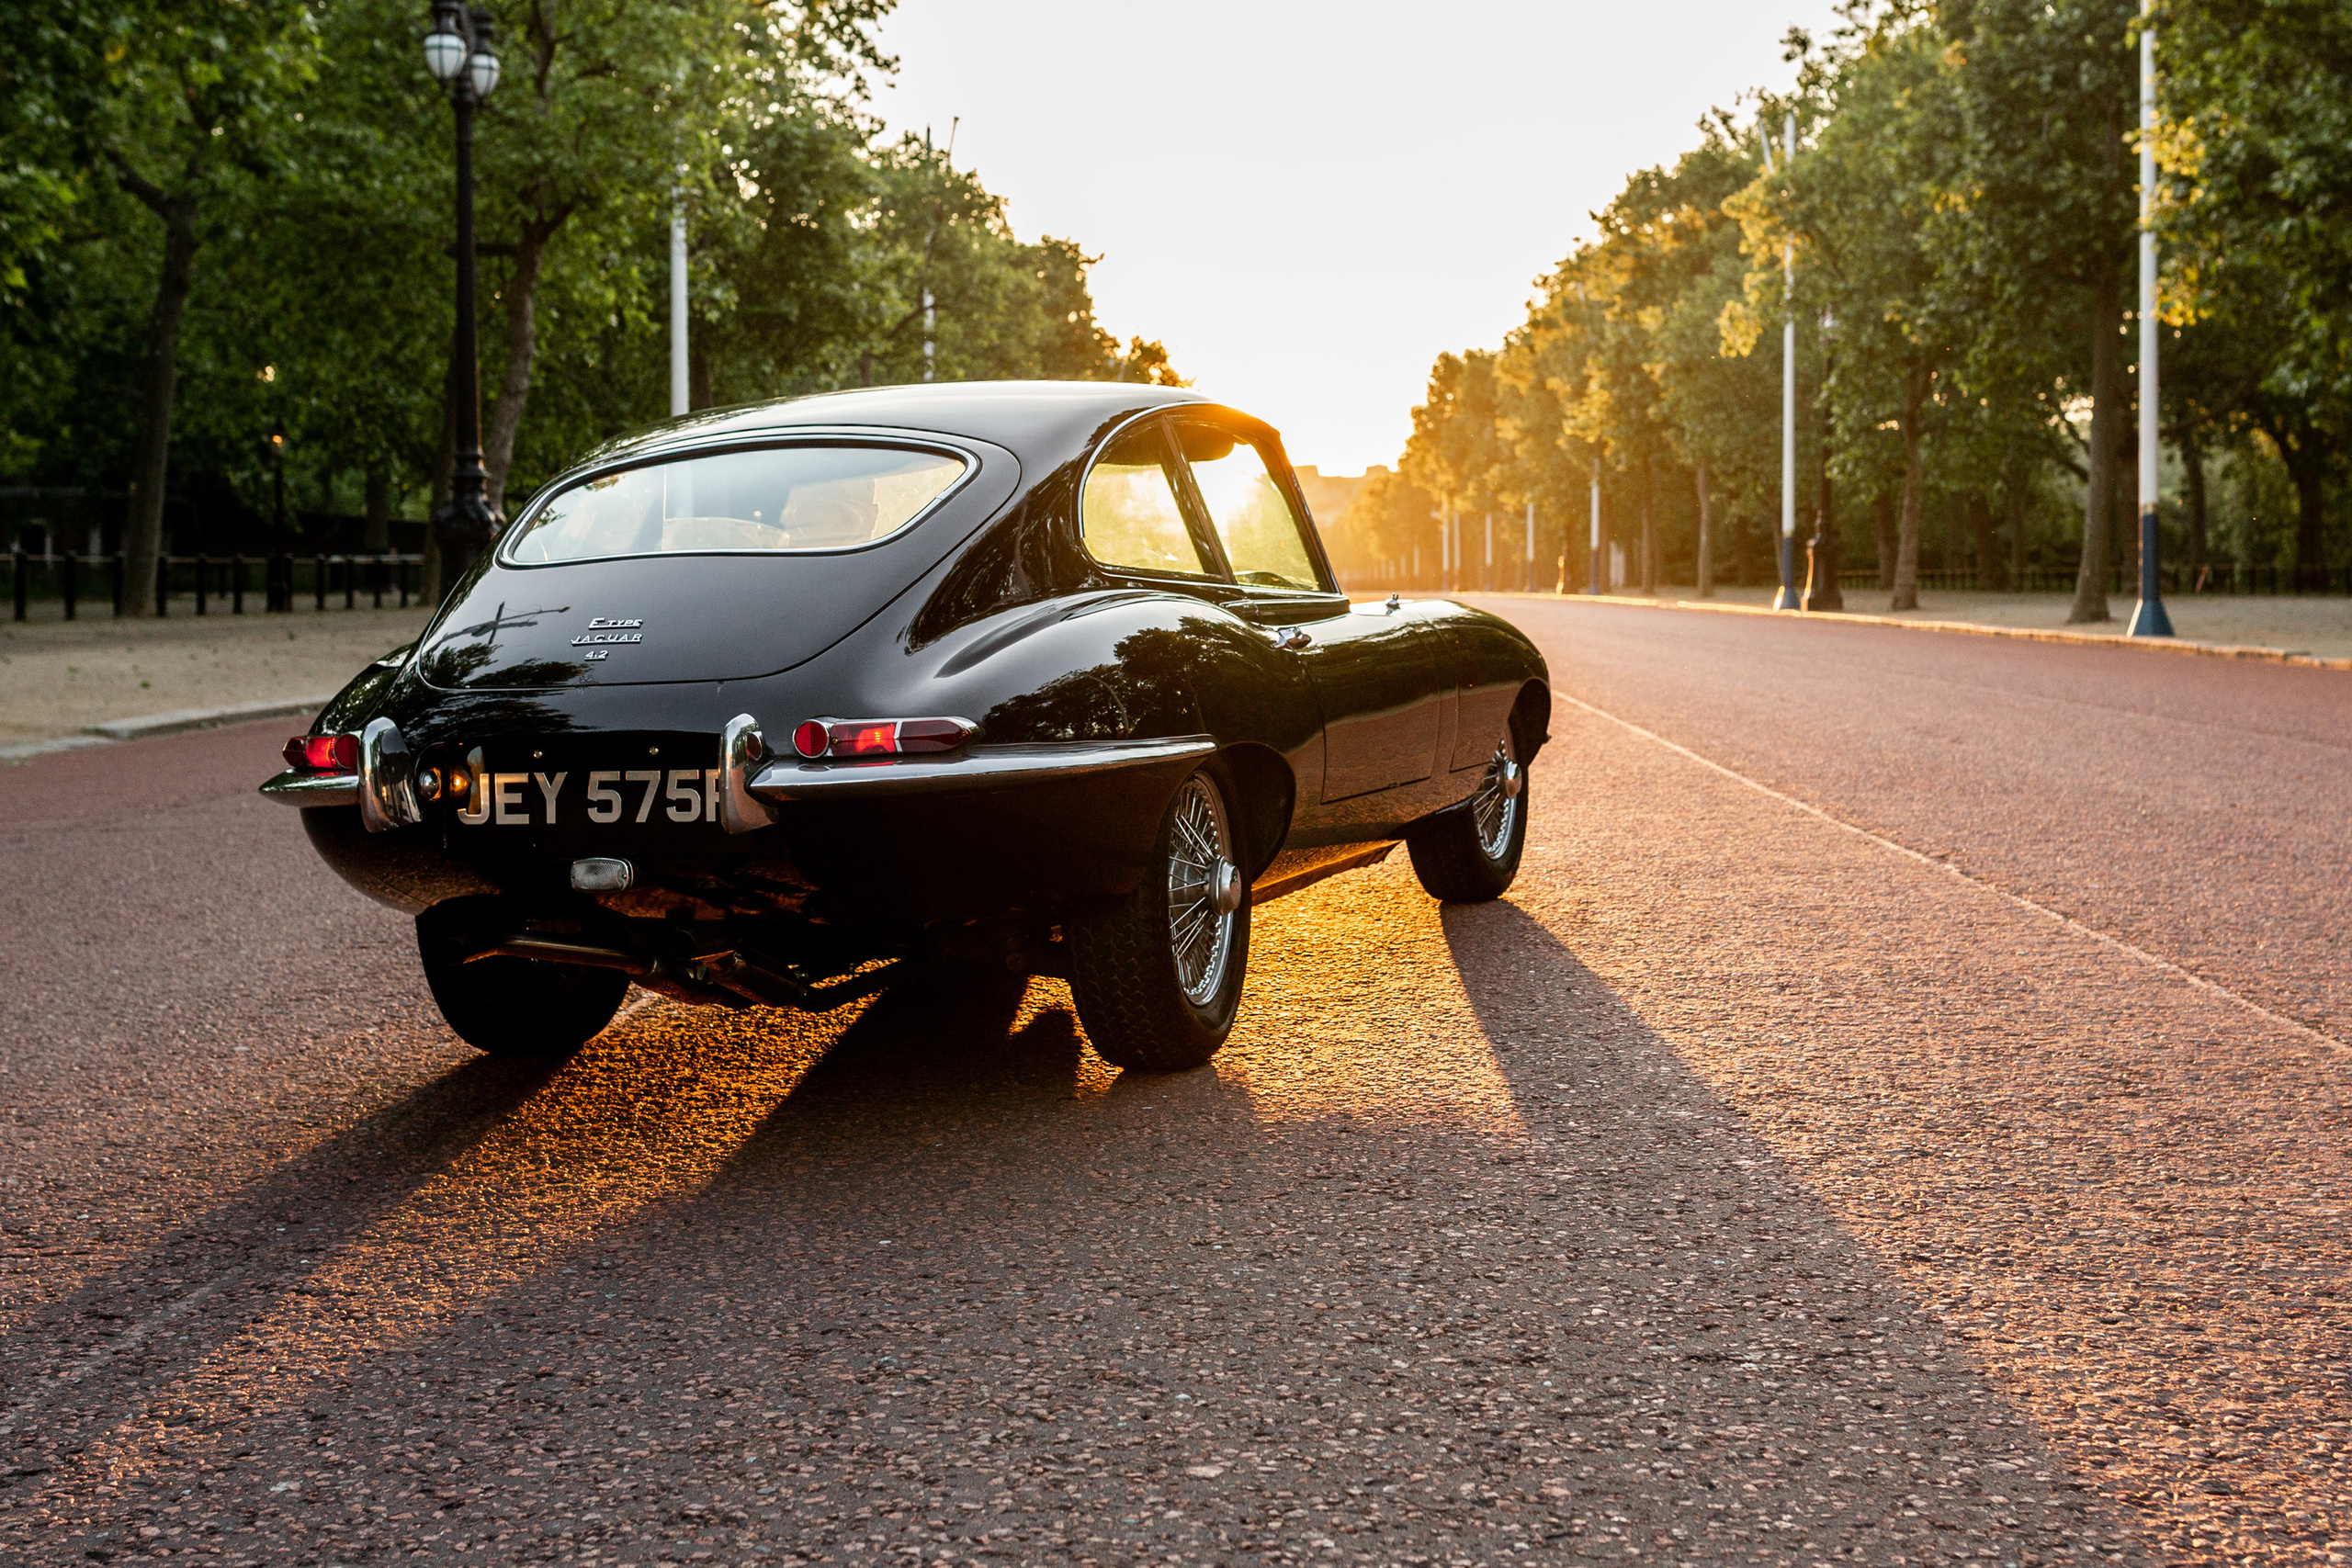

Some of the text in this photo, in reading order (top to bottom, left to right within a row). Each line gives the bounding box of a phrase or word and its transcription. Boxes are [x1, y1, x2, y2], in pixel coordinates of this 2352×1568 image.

[571, 633, 642, 645] JAGUAR
[584, 649, 608, 660] 4.2
[458, 772, 568, 825] JEY
